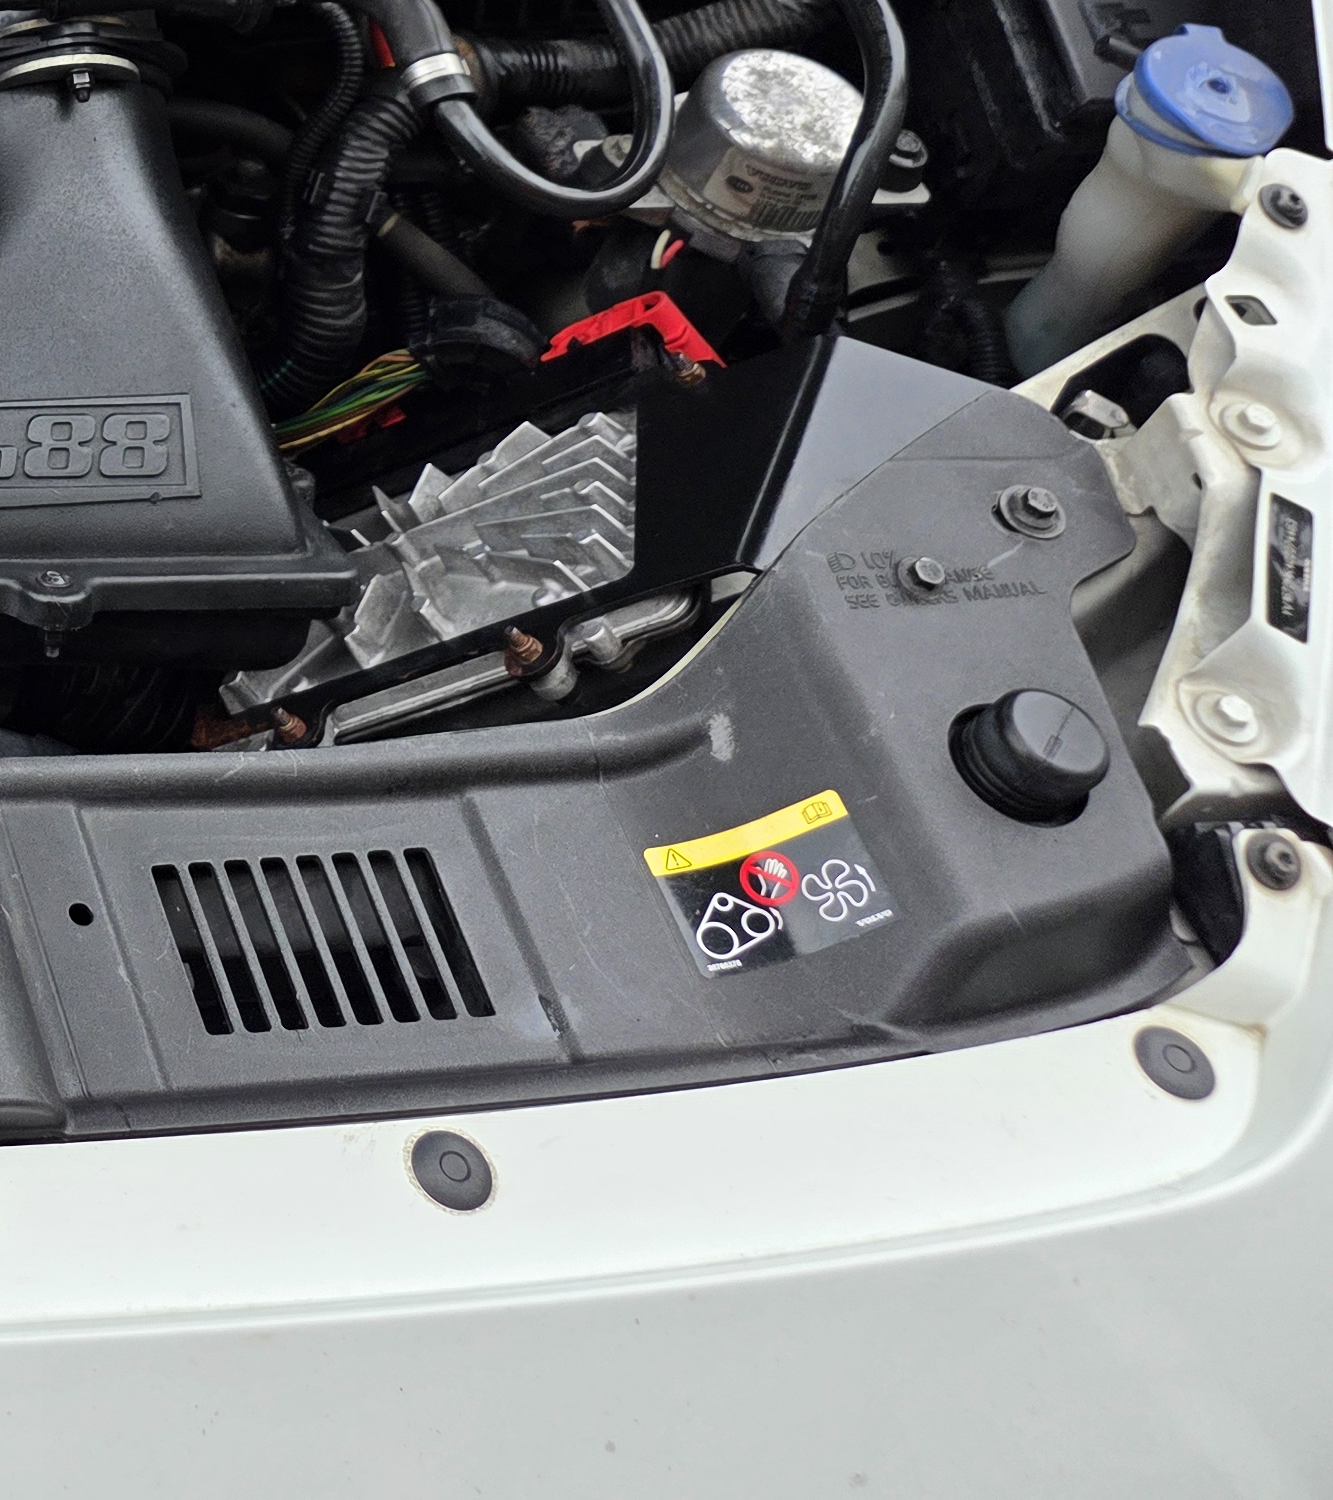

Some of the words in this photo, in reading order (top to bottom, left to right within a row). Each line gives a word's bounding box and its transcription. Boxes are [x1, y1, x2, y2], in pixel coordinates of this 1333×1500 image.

[835, 573, 874, 591] FOR
[844, 593, 881, 610] SEE
[962, 580, 1047, 602] MANUAL
[855, 909, 894, 927] VOLVO
